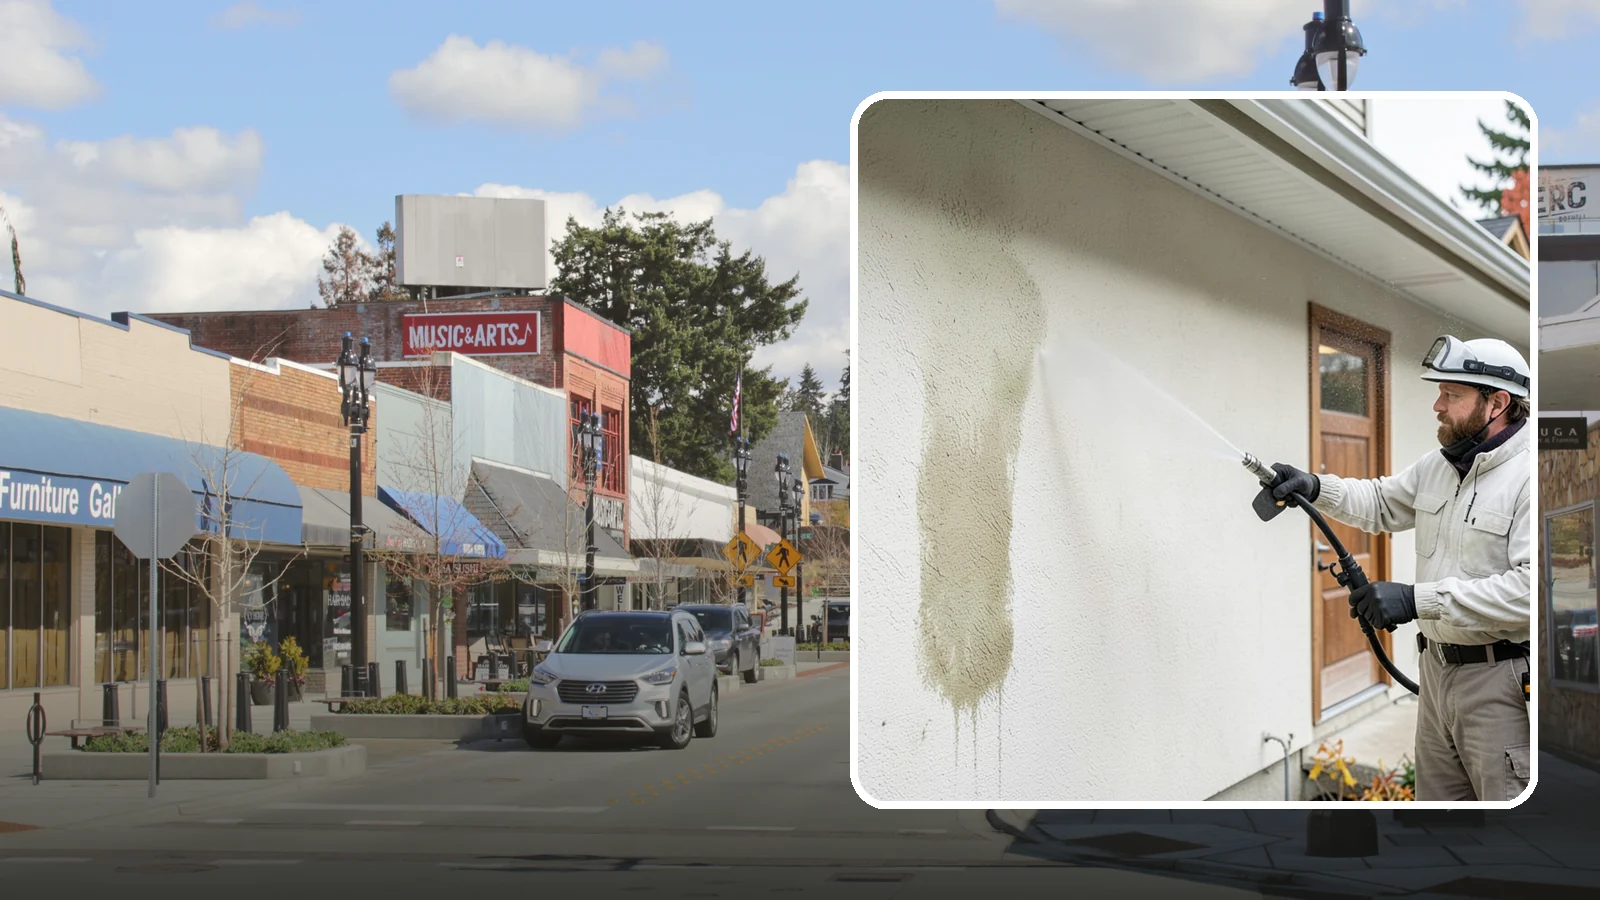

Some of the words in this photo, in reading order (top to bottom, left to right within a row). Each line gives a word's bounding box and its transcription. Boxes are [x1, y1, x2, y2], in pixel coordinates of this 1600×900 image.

[1540, 427, 1577, 437] UGA
[0, 472, 79, 515] Furniture
[90, 483, 122, 519] Gal
[453, 563, 479, 574] SUSHI
